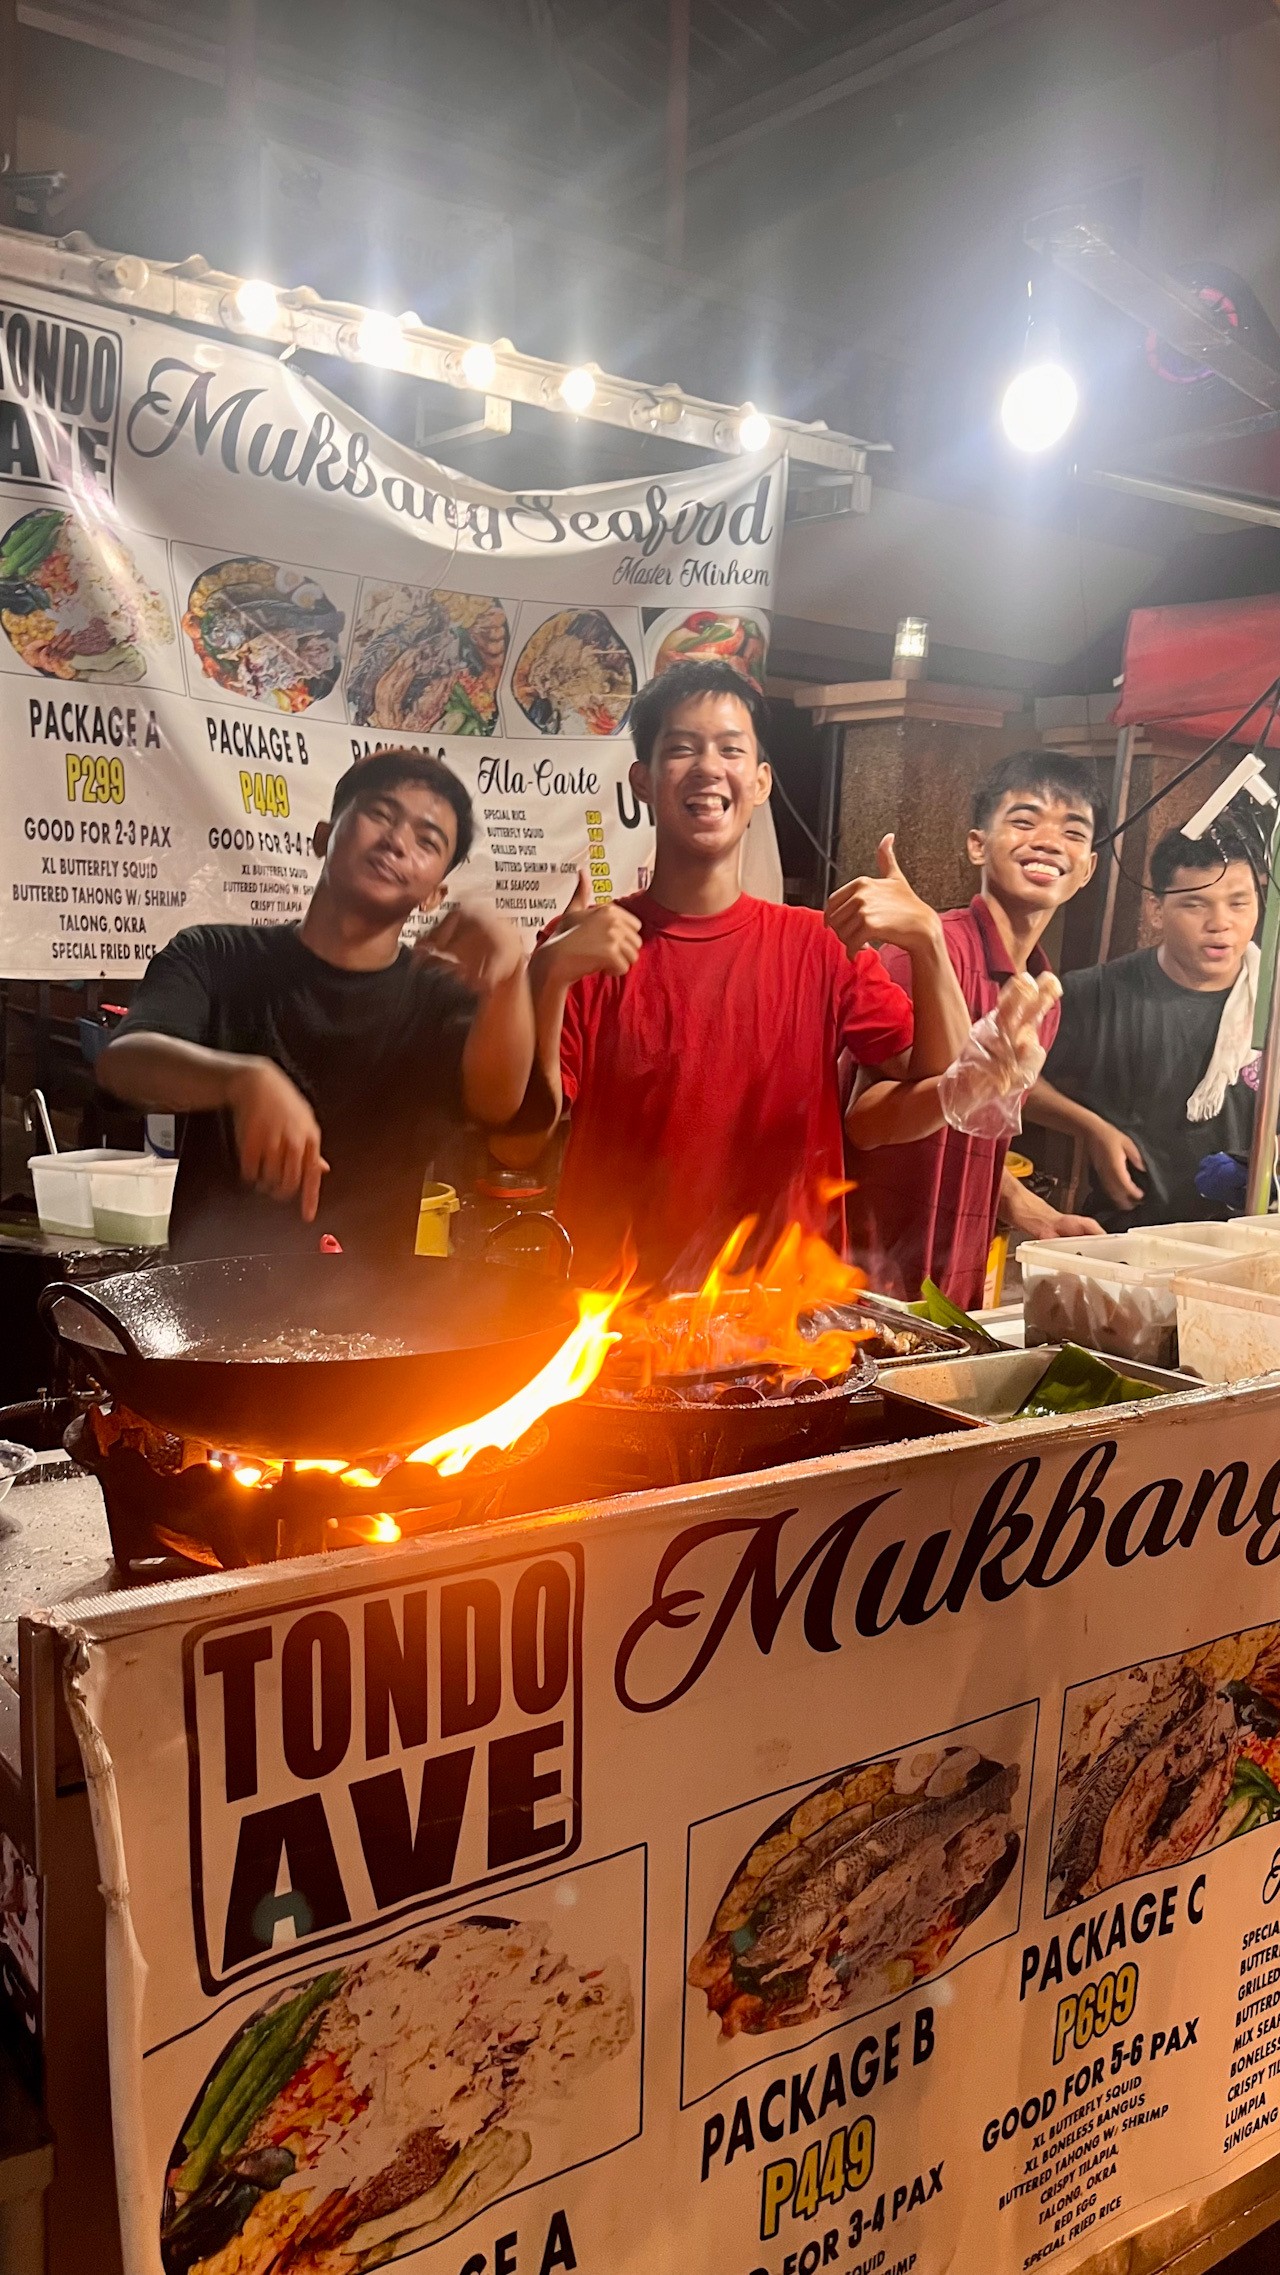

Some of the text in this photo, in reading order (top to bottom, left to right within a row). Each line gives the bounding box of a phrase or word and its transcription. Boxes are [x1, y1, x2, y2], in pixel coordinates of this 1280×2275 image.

[0, 311, 118, 424] ONDO
[0, 401, 110, 489] AVE
[612, 555, 771, 587] Master Mirhem
[29, 698, 161, 749] PACKAGE A
[206, 717, 294, 764] PACKAGE
[296, 731, 309, 765] B
[65, 753, 126, 804] P299
[239, 770, 291, 818] P449
[477, 756, 601, 797] Ala-Carte
[24, 817, 171, 848] GOOD FOR 2-3 PAX
[484, 809, 511, 820] SPECIAL
[511, 810, 527, 821] RICE
[208, 827, 255, 851] GOOD
[259, 832, 283, 855] FOR
[284, 831, 303, 857] 3-4
[487, 827, 521, 838] BUTTERFLY
[522, 827, 545, 839] SQUID
[491, 844, 518, 855] GRILLED
[518, 845, 537, 856] PUSIT
[41, 857, 158, 879] XL BUTTERFLY SQUID
[252, 865, 287, 877] BUTTERFLY
[289, 867, 309, 879] SQUID
[495, 878, 613, 893] MIX SEAFOOD 250
[523, 862, 548, 874] SHRIMP
[590, 862, 611, 877] 220
[12, 884, 69, 904] BUTTERED
[71, 886, 123, 906] TAHONG
[145, 890, 187, 907] SHRIMP
[223, 881, 258, 893] BUTTERED
[259, 882, 291, 895] TAHONG
[495, 898, 527, 909] BONELESS
[250, 900, 303, 912] CRISPY TILAPIA
[520, 916, 545, 927] TILAPIA
[60, 914, 147, 934] TALONG, OKRA
[52, 942, 97, 960] SPECIAL
[100, 943, 131, 961] FRIED
[203, 1559, 571, 1804] TONDO
[221, 1720, 567, 1975] AVE
[1019, 1884, 1179, 2001] PACKAGE
[1187, 1873, 1206, 1925] C
[1242, 1920, 1280, 1951] SPECIA
[1240, 1944, 1280, 1976] BUTTER
[1237, 1968, 1280, 2002] GRILLED
[1052, 1961, 1139, 2066] P699
[1233, 2028, 1254, 2054] MIX
[701, 2006, 936, 2183] PACKAGE B
[982, 2017, 1200, 2153] GOOD FOR 5-6 PAX
[1227, 2069, 1265, 2103] CRISPY
[1032, 2076, 1142, 2151] XL BUTTERFLY SQUID
[1225, 2091, 1266, 2129] LUMPIA
[1023, 2093, 1146, 2175] XL BONELESS BANGUS
[1223, 2106, 1279, 2154] SINIGANG
[999, 2168, 1052, 2211] BUTTERED
[1055, 2138, 1101, 2175] TAHONG
[1121, 2104, 1169, 2133] SHRIMP
[760, 2114, 876, 2241] P449
[1040, 2169, 1076, 2205] CRISPY
[1086, 2162, 1117, 2190] OKRA
[783, 2160, 945, 2275] FOR 3-4 PAX
[1054, 2193, 1098, 2234] RED EGG
[539, 2209, 577, 2275] A
[1022, 2196, 1122, 2271] SPECIAL FRIED RICE
